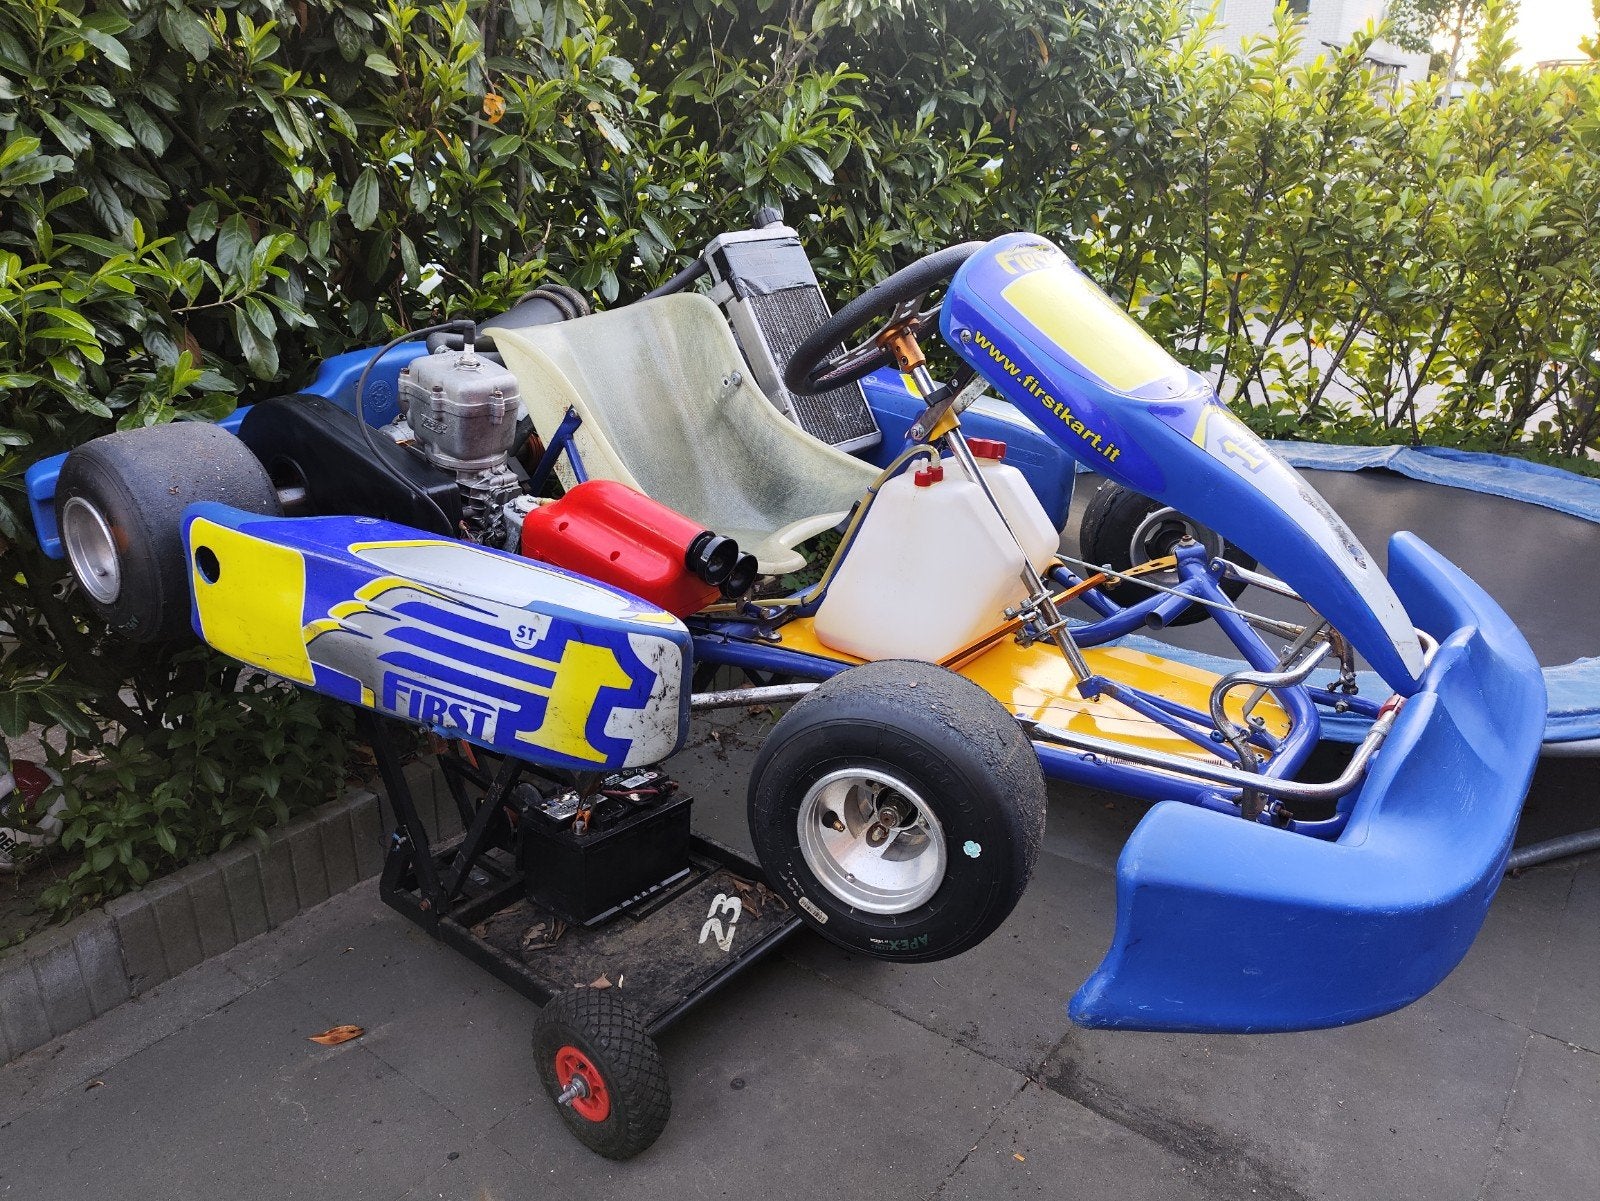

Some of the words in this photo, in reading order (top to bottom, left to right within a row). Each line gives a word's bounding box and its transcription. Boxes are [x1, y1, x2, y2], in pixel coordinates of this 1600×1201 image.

[973, 330, 1121, 463] www.firstkart.it
[516, 624, 537, 641] ST
[383, 671, 497, 740] FIRST
[698, 893, 742, 951] 23
[888, 933, 928, 951] APEX
